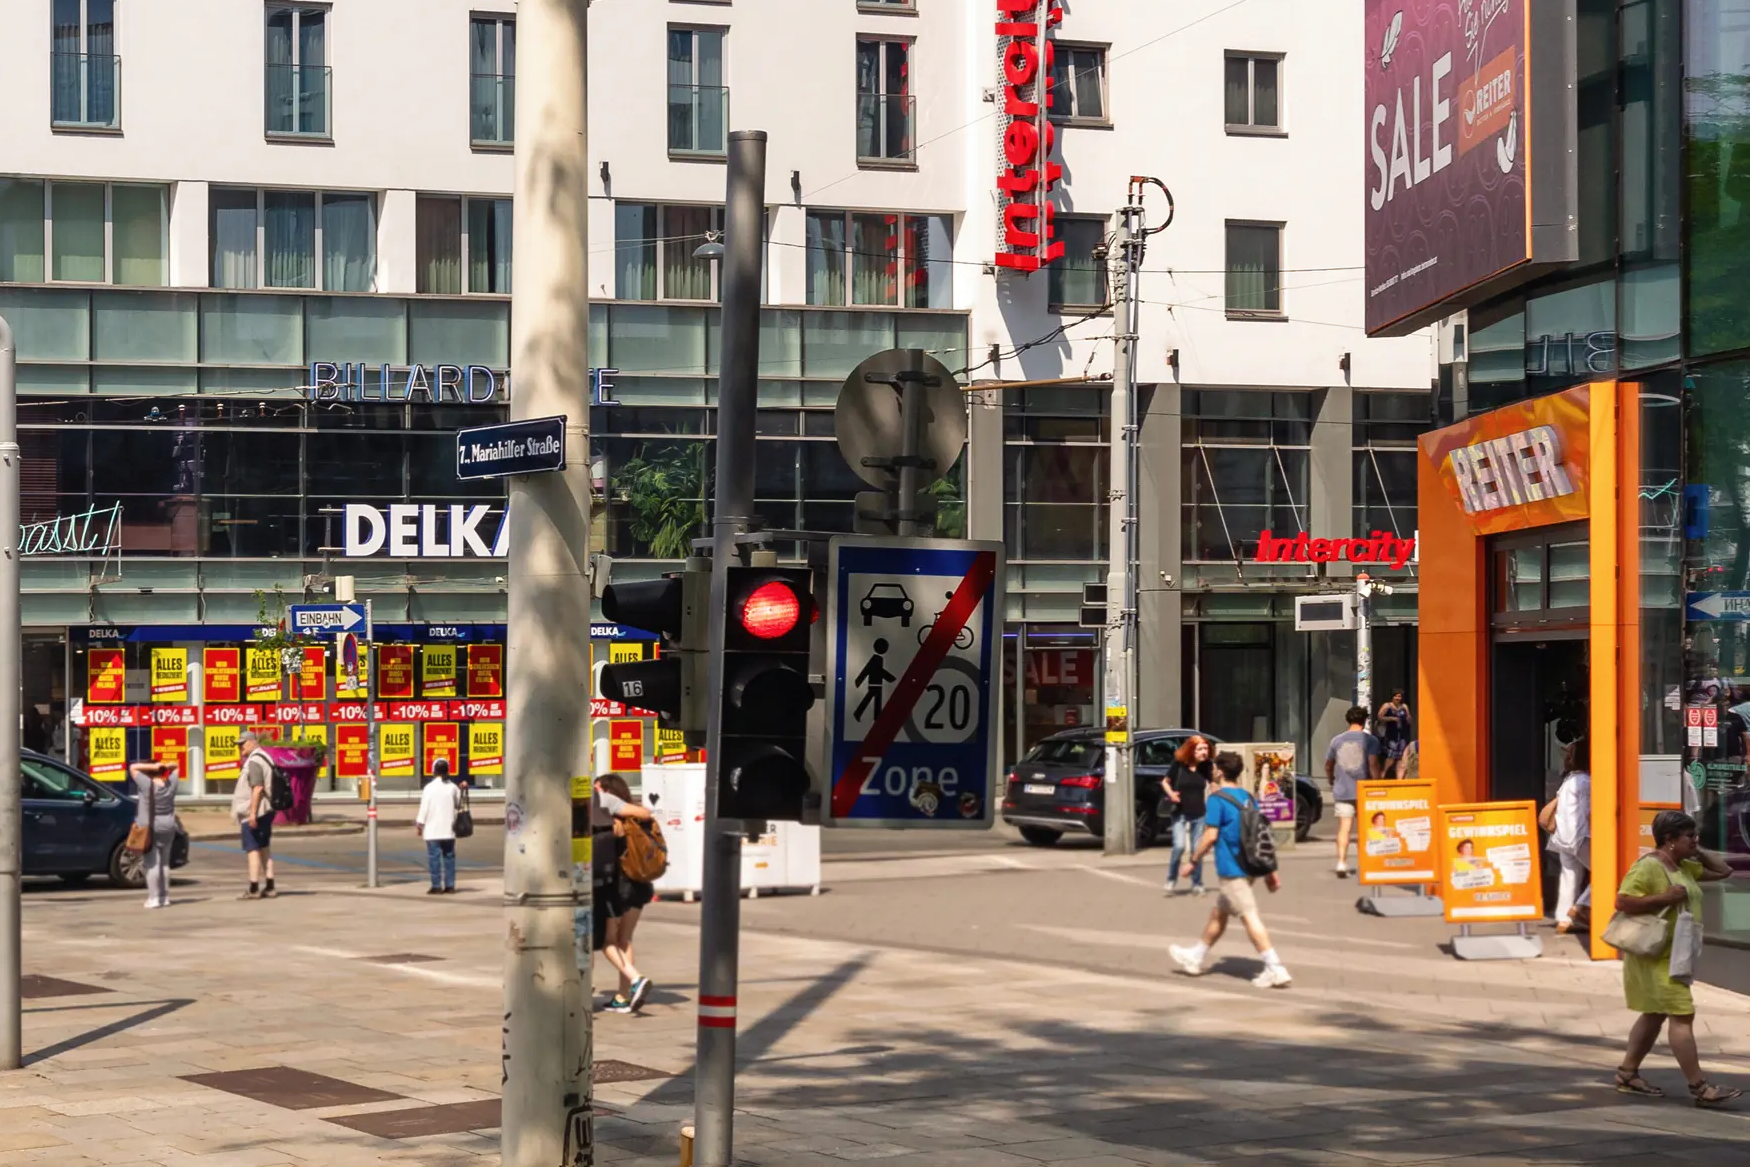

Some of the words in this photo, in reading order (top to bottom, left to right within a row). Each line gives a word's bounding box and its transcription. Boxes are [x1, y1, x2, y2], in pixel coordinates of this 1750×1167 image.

[1476, 70, 1511, 115] REITER
[1370, 51, 1452, 212] SALE
[310, 362, 495, 403] BILLARD
[471, 439, 525, 463] Mariahilfer
[526, 435, 560, 456] Straße
[1450, 424, 1574, 514] REITER
[1256, 530, 1416, 570] Intercity
[300, 613, 342, 625] EINBAHN
[89, 629, 119, 638] DELKA
[429, 627, 457, 637] DELKA
[591, 627, 618, 636] DELKA
[156, 658, 183, 671] ALLES
[252, 657, 277, 671] ALLES
[427, 654, 452, 667] ALLES
[1003, 651, 1079, 684] SALE
[624, 682, 642, 697] 16
[392, 705, 429, 718] -10%
[452, 704, 488, 717] -10%
[923, 684, 971, 730] 20
[206, 708, 243, 722] -10%
[95, 737, 121, 750] ALLES
[210, 735, 236, 749] ALLES
[385, 734, 410, 746] ALLES
[474, 732, 498, 745] ALLES
